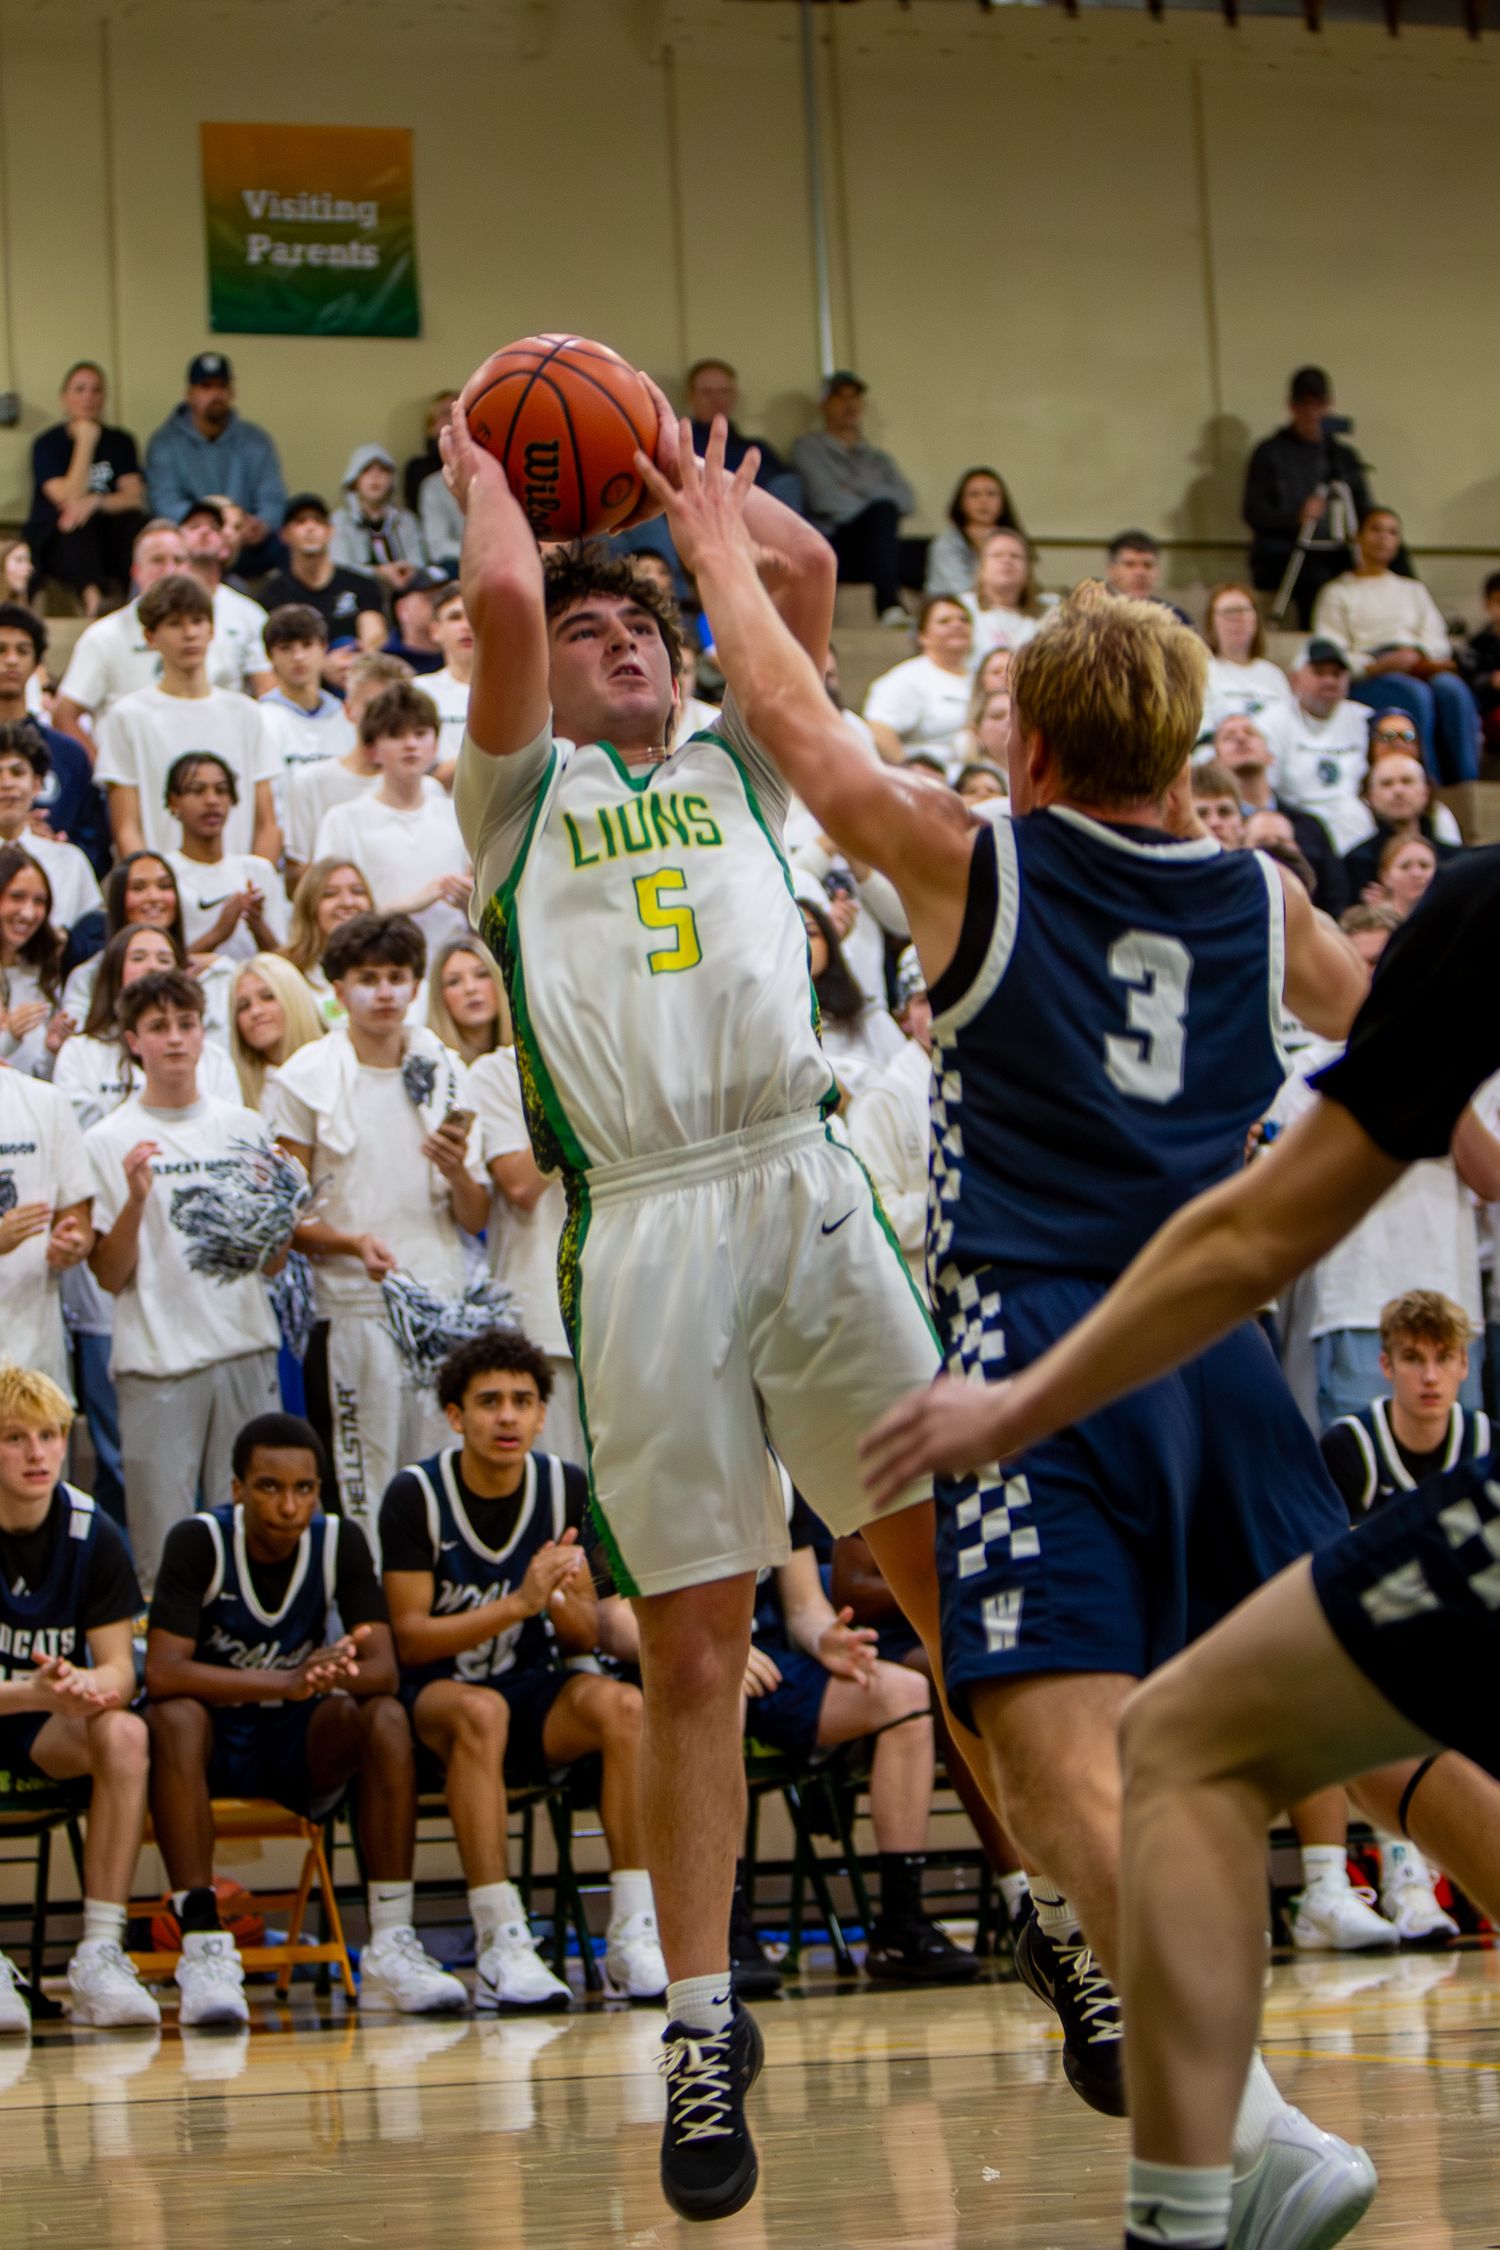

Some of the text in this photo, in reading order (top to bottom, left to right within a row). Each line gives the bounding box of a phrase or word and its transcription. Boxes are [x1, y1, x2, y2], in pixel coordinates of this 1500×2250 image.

[241, 189, 378, 229] Visiting
[245, 233, 379, 269] Parents
[562, 791, 723, 868] LIONS
[632, 866, 703, 975] 5
[1104, 928, 1194, 1104] 3
